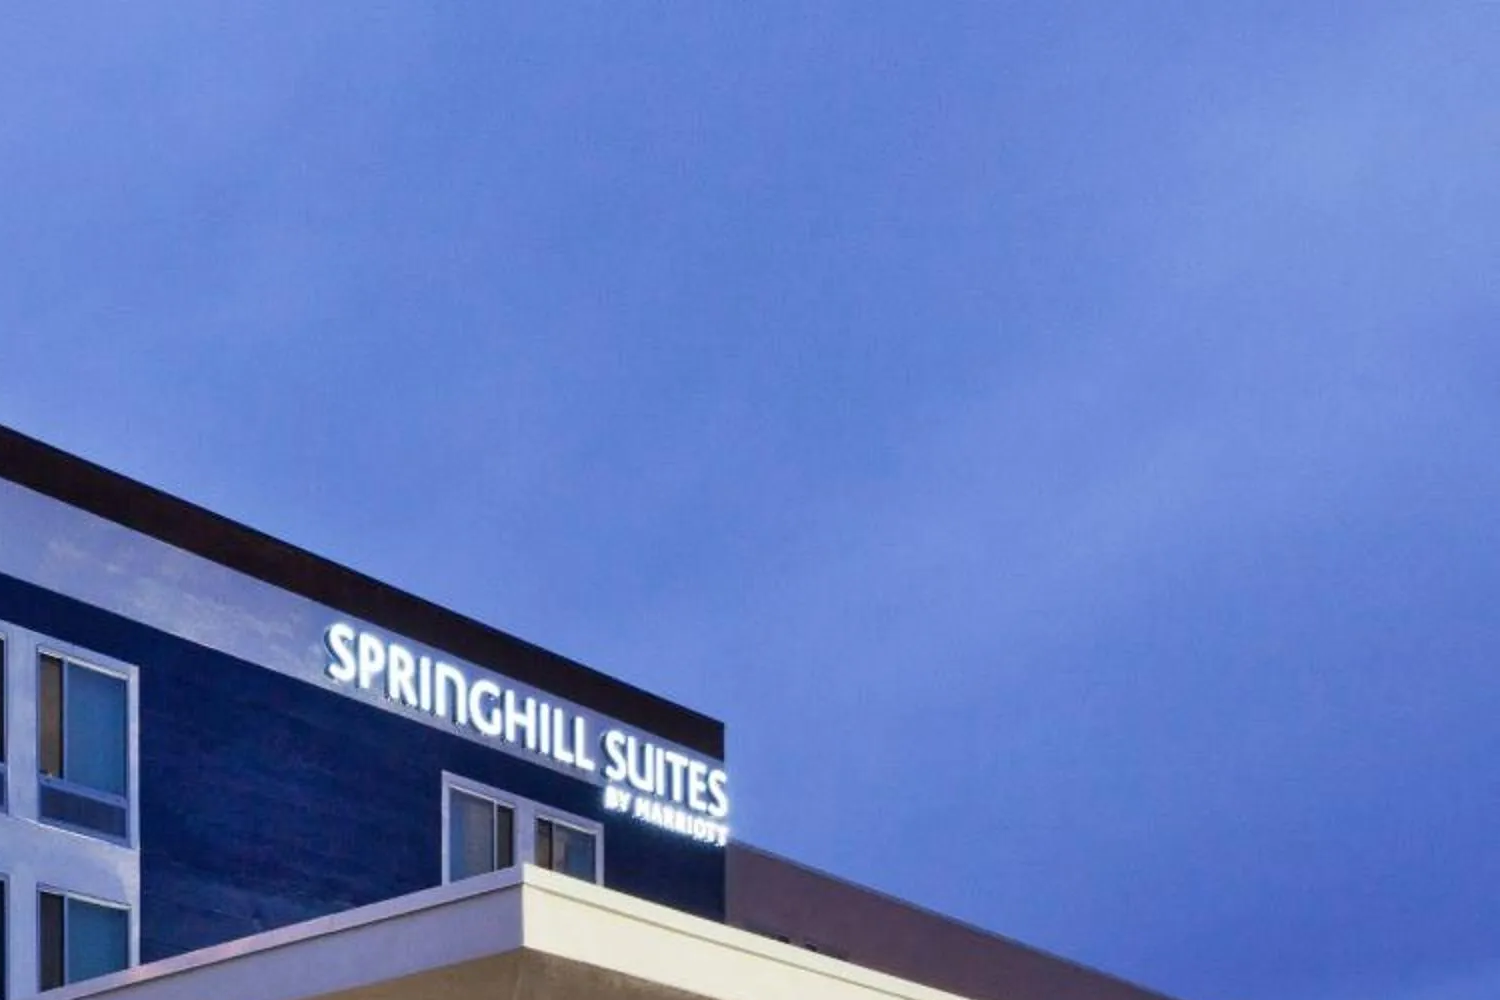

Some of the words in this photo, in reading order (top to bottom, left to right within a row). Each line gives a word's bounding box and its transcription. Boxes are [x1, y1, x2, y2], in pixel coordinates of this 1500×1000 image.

[327, 621, 596, 772] SPRINGHILL
[603, 729, 729, 818] SUITES
[603, 784, 632, 813] BY
[633, 797, 729, 847] MARRIOTT
